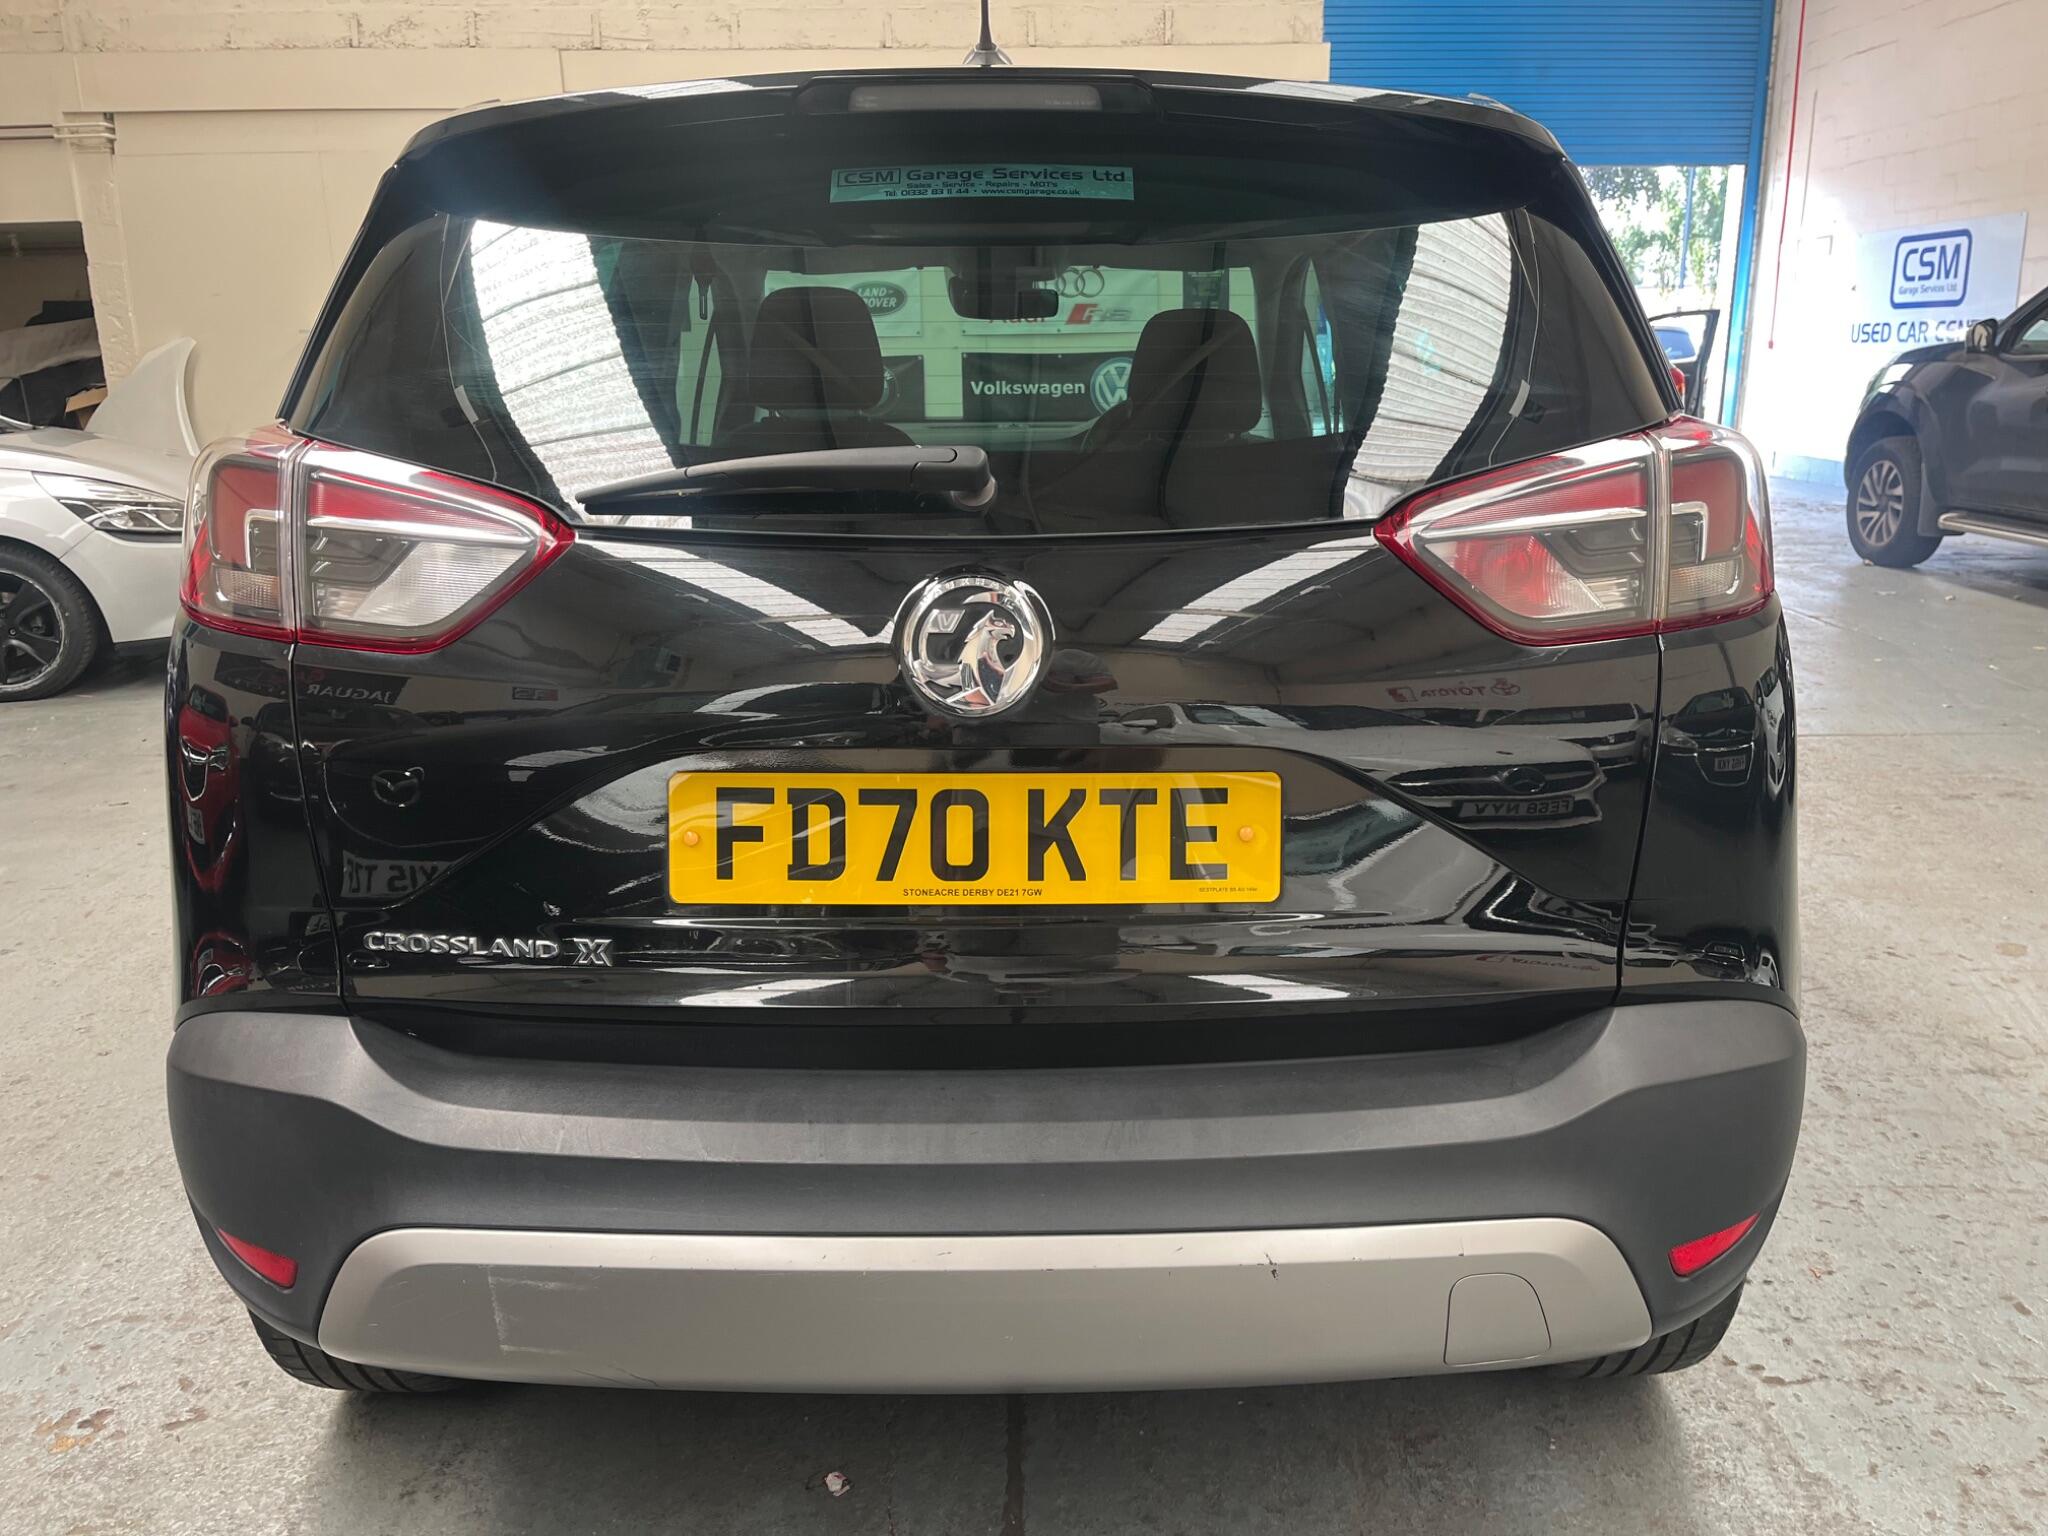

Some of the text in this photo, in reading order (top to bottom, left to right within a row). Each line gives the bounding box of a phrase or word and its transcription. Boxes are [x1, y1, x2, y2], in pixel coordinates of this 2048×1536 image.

[844, 167, 1126, 184] CSM Garage Services Ltd
[1902, 243, 1962, 282] CSM
[1851, 322, 1892, 343] USED
[1897, 320, 1929, 343] CAR
[970, 380, 1086, 398] Volkswagen
[716, 787, 1229, 882] FD70 KTE
[903, 888, 1043, 897] STONEACRE DERBY DE21 7GW
[363, 931, 613, 967] CROSSLAND X
